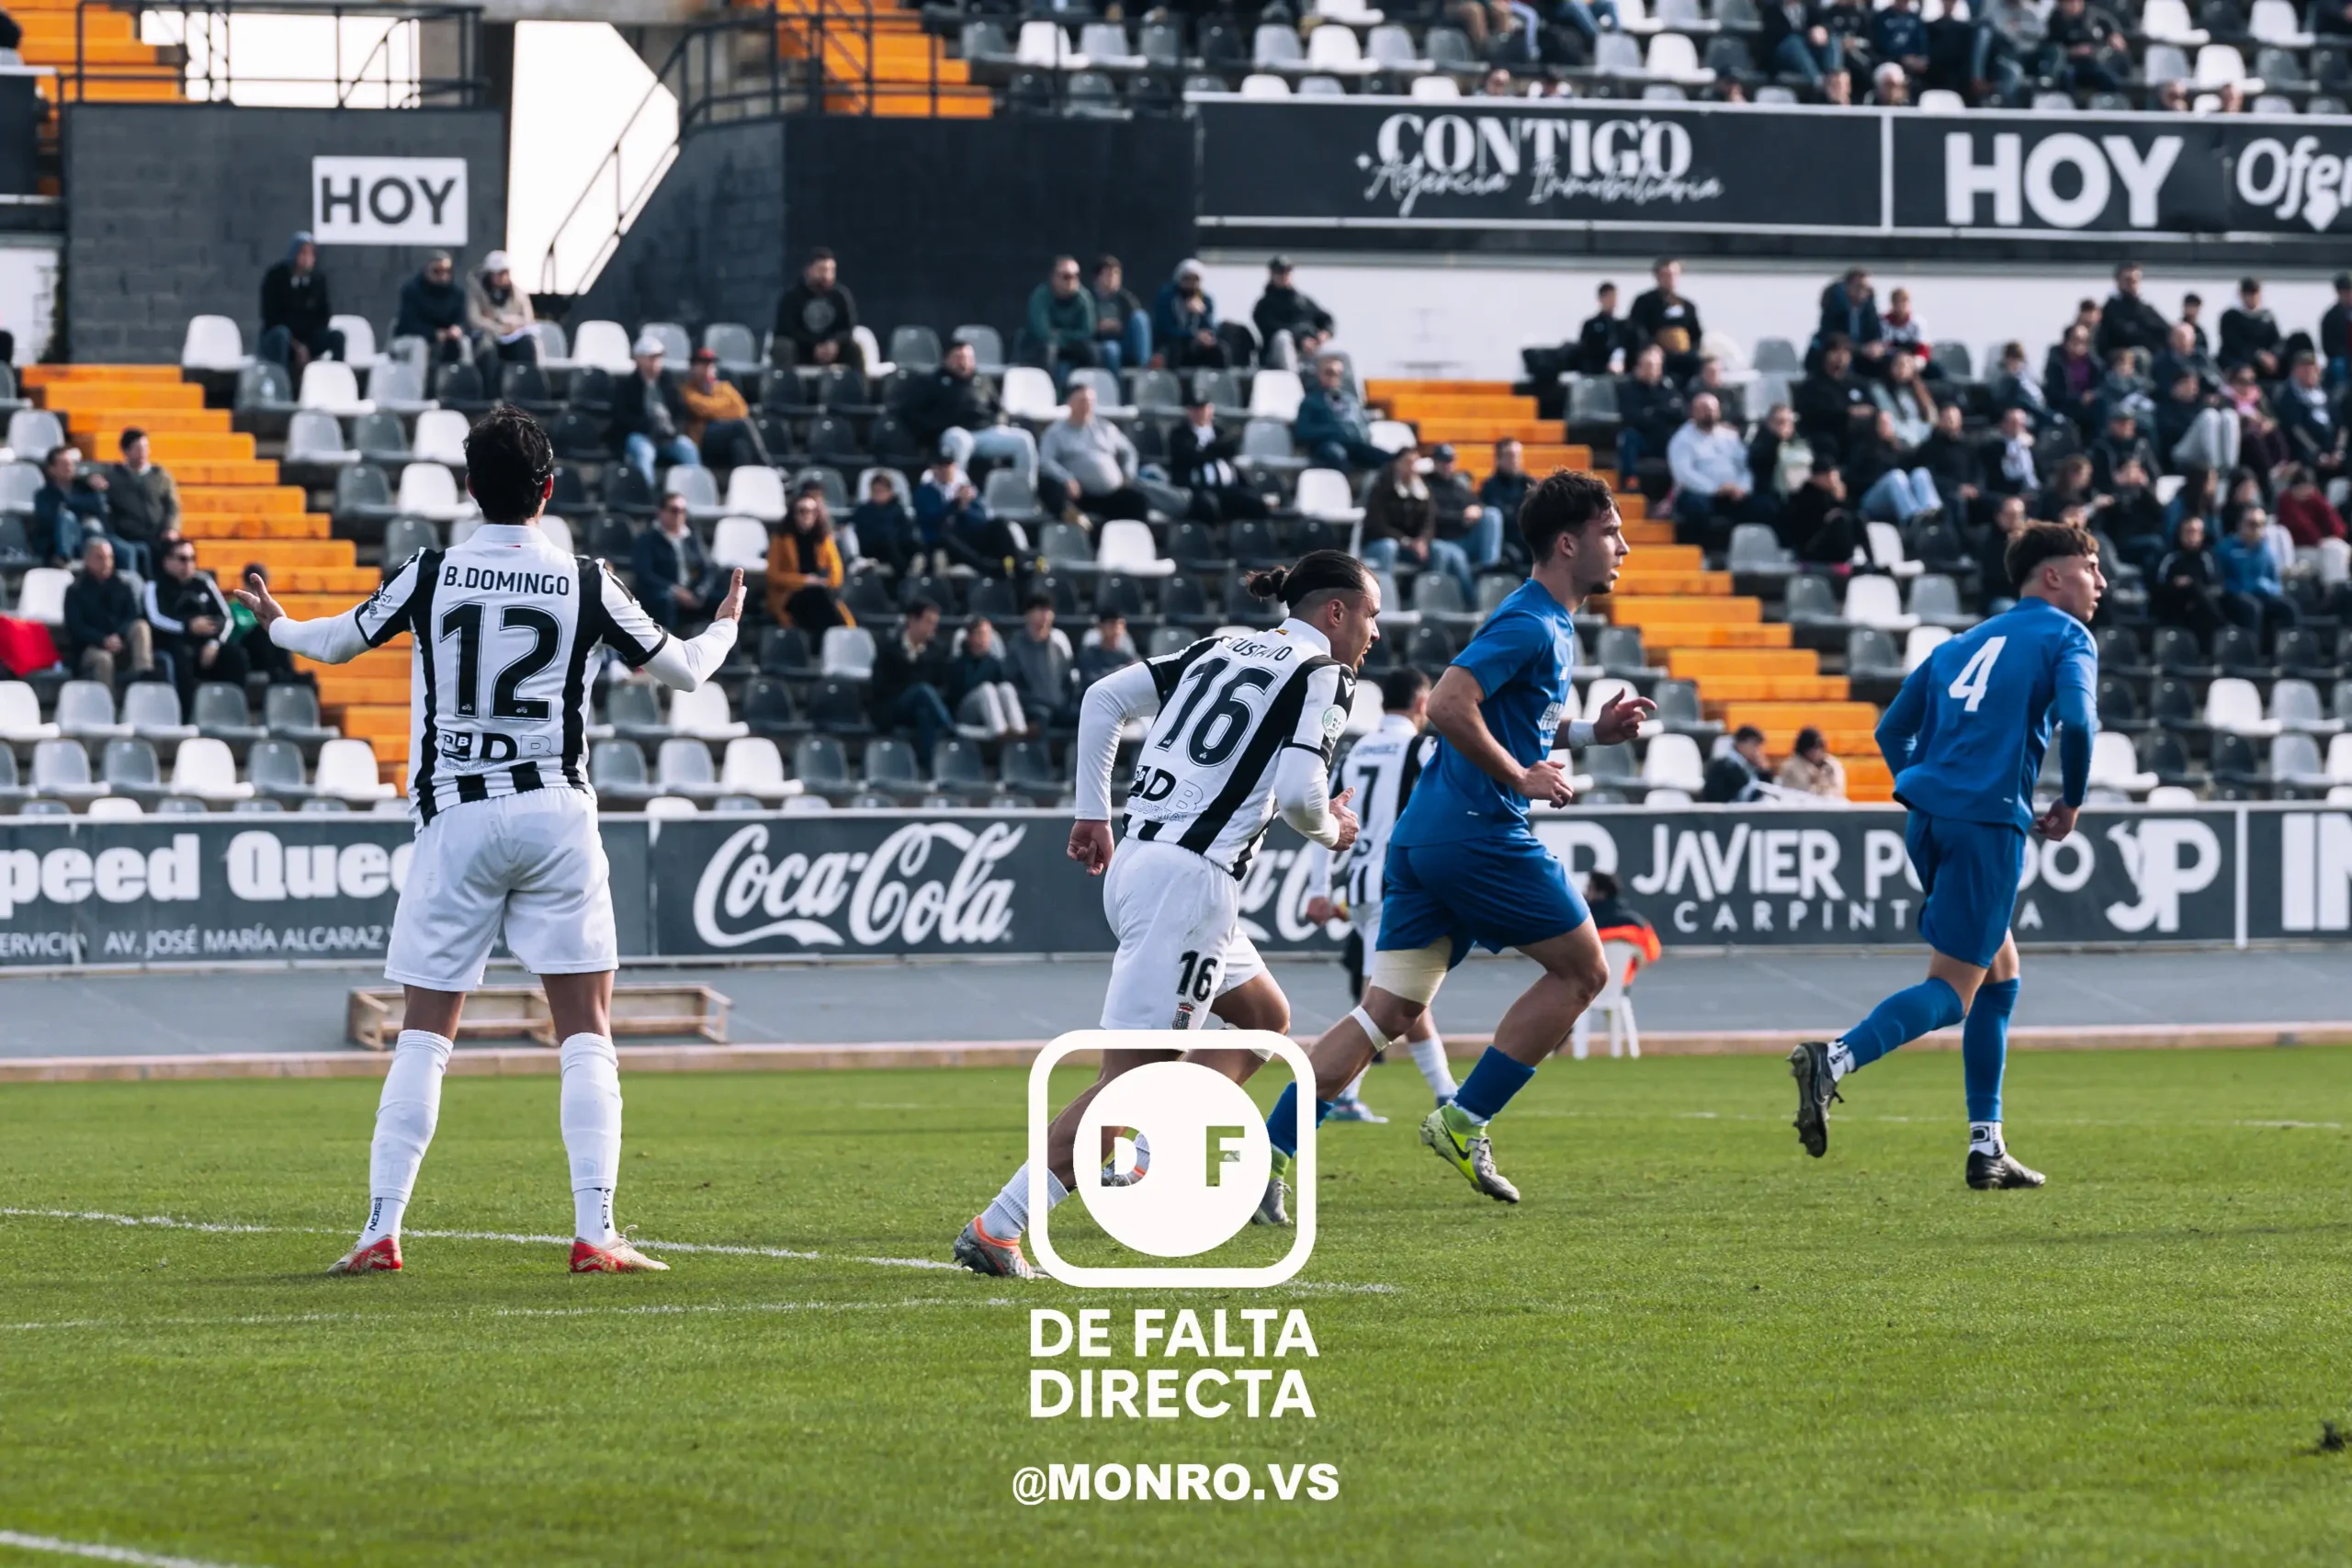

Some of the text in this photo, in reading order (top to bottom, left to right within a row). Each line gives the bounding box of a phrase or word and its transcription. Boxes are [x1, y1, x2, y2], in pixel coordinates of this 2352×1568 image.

[1377, 112, 1692, 180] CONTIGO
[1944, 131, 2184, 228] HOY
[2236, 135, 2352, 220] Ofe
[320, 177, 457, 226] HOY
[443, 566, 570, 596] B.DOMINGO
[439, 601, 562, 721] 12
[1948, 636, 2007, 712] 4
[1155, 656, 1279, 767] 16
[1357, 765, 1380, 829] 7
[693, 822, 1027, 946] Coca-Cola
[1631, 823, 1846, 901] JAVIER
[103, 931, 141, 954] AV.
[145, 924, 198, 960] JOSÉ
[204, 922, 278, 953] MARÍA
[280, 926, 384, 951] ALCARAZ
[1673, 898, 2043, 932] CARPINTA
[1176, 950, 1218, 1003] 16
